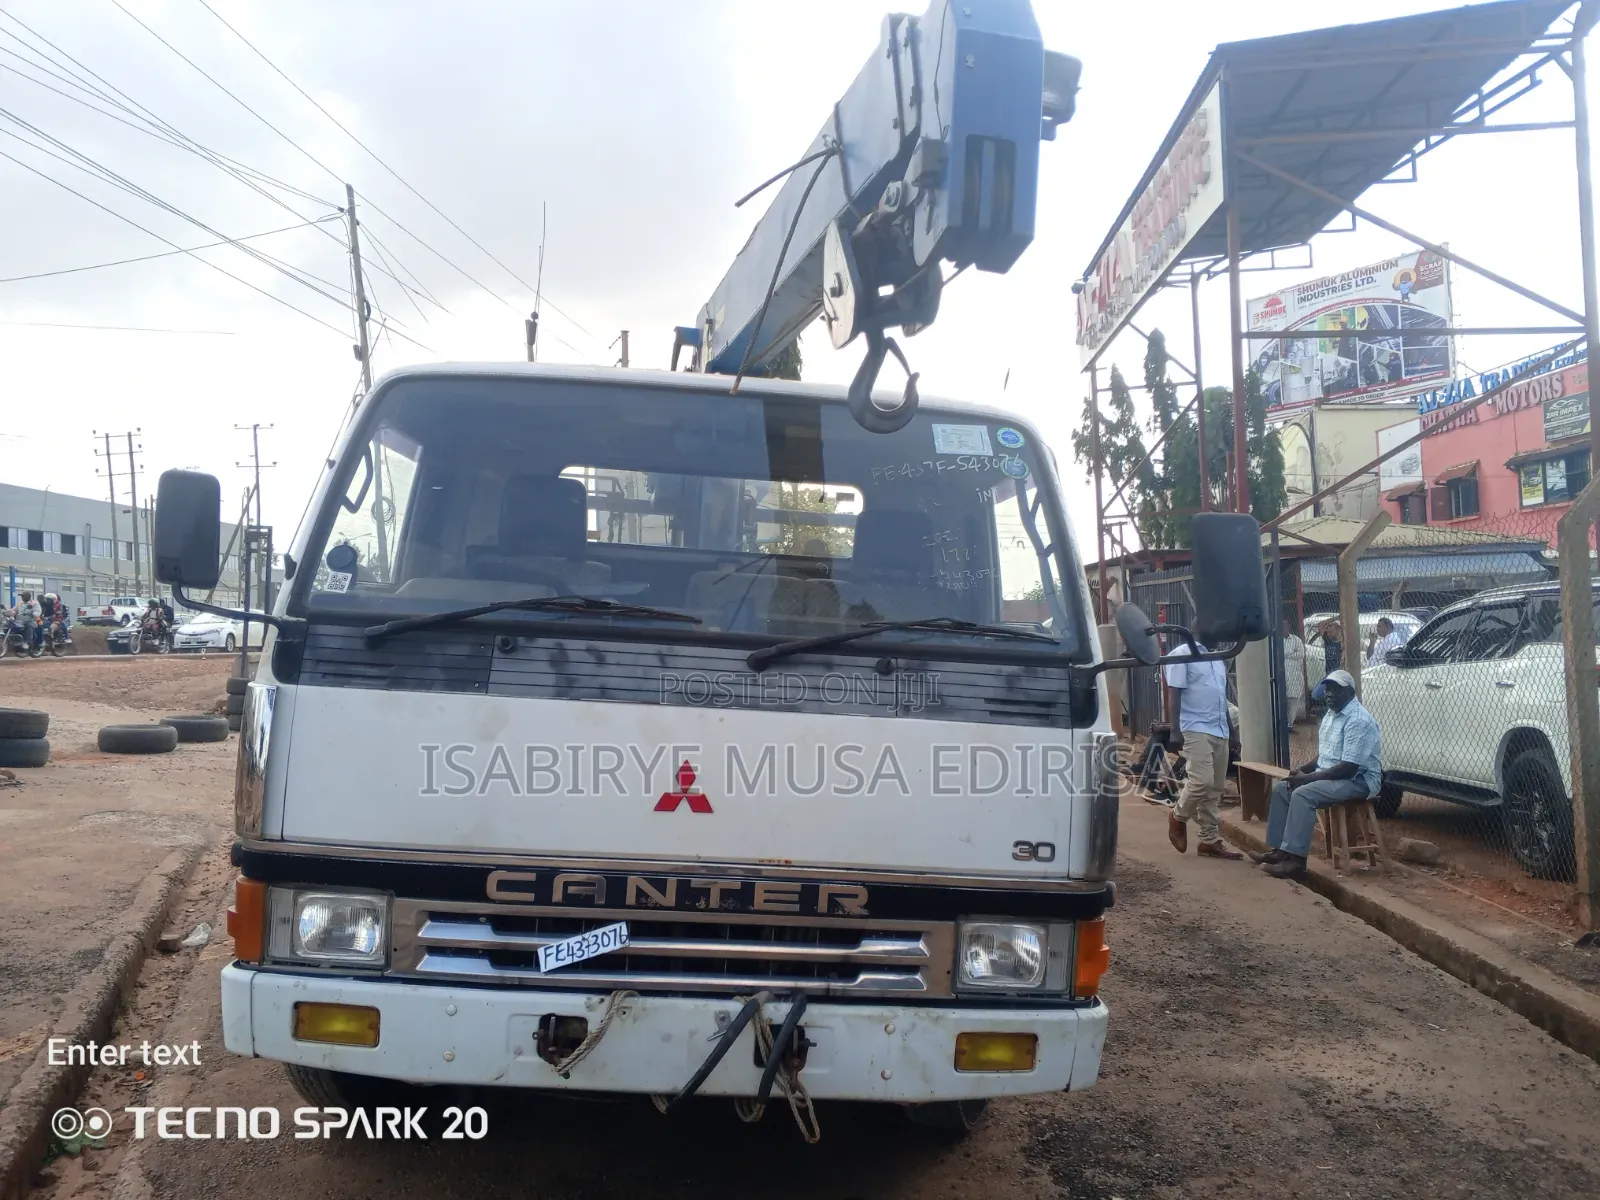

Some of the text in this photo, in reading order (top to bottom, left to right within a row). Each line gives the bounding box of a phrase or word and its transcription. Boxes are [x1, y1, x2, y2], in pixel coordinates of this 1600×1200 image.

[1297, 278, 1338, 296] SHUMUK
[1340, 259, 1399, 283] ALUMINIUM
[1419, 260, 1442, 272] SCRAP
[1297, 282, 1353, 304] INDUSTRIES
[1355, 276, 1377, 288] LTD.
[1260, 305, 1287, 319] SHUMUK
[1495, 373, 1564, 415] MOTORS
[1560, 403, 1583, 416] IMPEX
[1012, 839, 1056, 862] 30
[486, 871, 870, 915] CANTER
